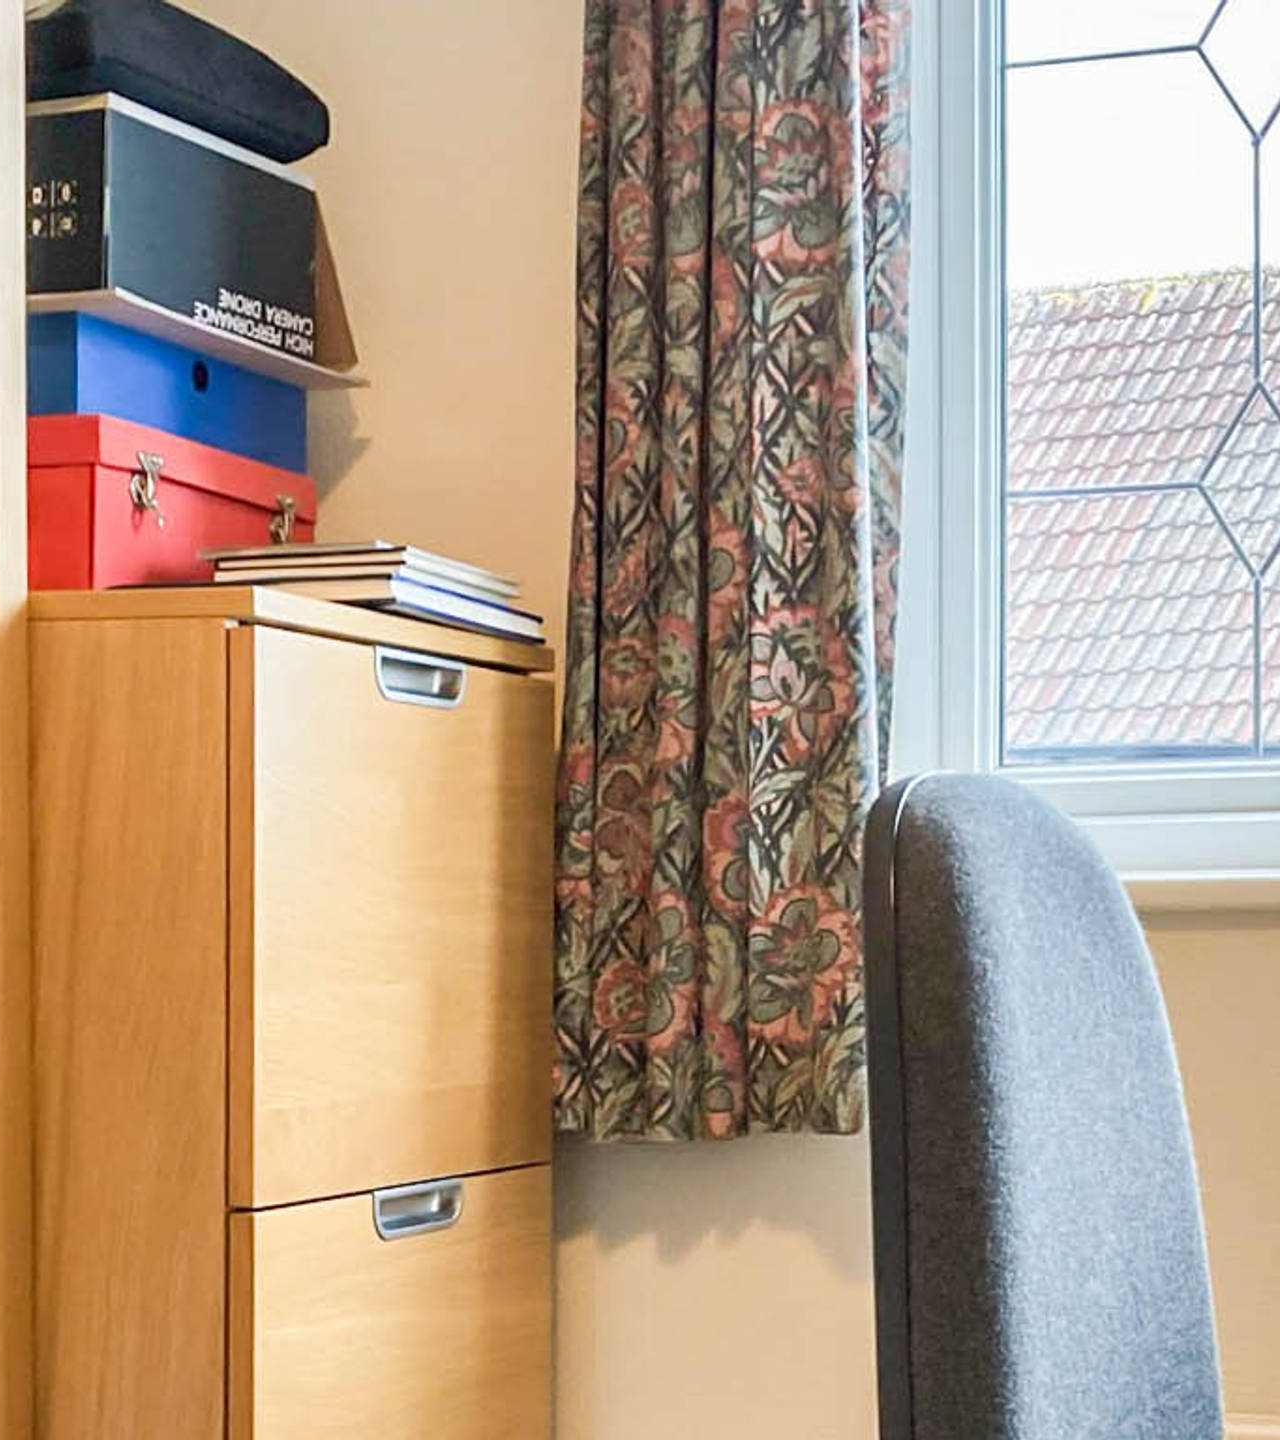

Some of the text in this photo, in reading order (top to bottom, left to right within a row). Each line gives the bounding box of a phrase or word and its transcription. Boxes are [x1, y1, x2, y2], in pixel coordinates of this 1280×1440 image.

[193, 301, 314, 357] HIGH PERFORMANCE
[218, 288, 314, 337] CAMERA DRONE
